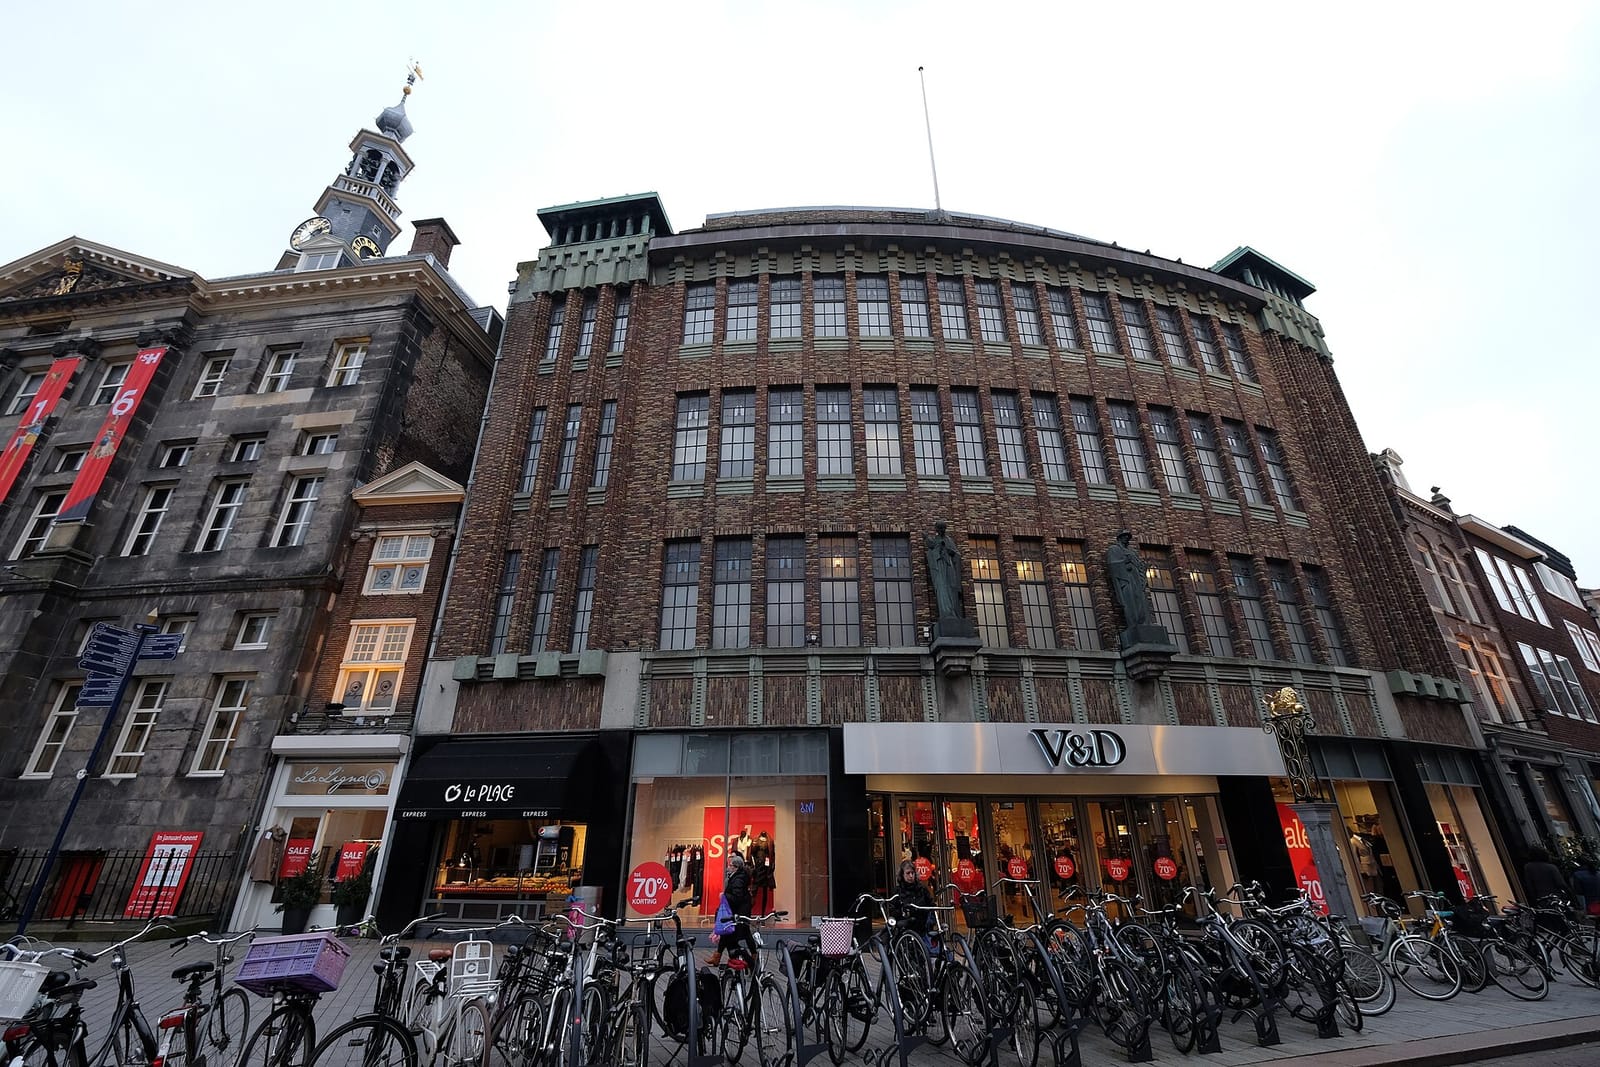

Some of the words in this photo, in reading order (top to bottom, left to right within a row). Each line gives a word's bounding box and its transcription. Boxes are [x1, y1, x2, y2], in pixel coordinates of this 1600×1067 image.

[32, 400, 48, 424] 1
[111, 389, 138, 416] 6
[1029, 728, 1126, 769] V&D
[295, 766, 319, 783] La
[463, 785, 476, 802] La
[478, 784, 515, 802] PLACE
[1284, 818, 1311, 848] ale
[287, 846, 310, 855] SALE
[342, 851, 363, 860] SALE
[633, 877, 669, 898] 70%
